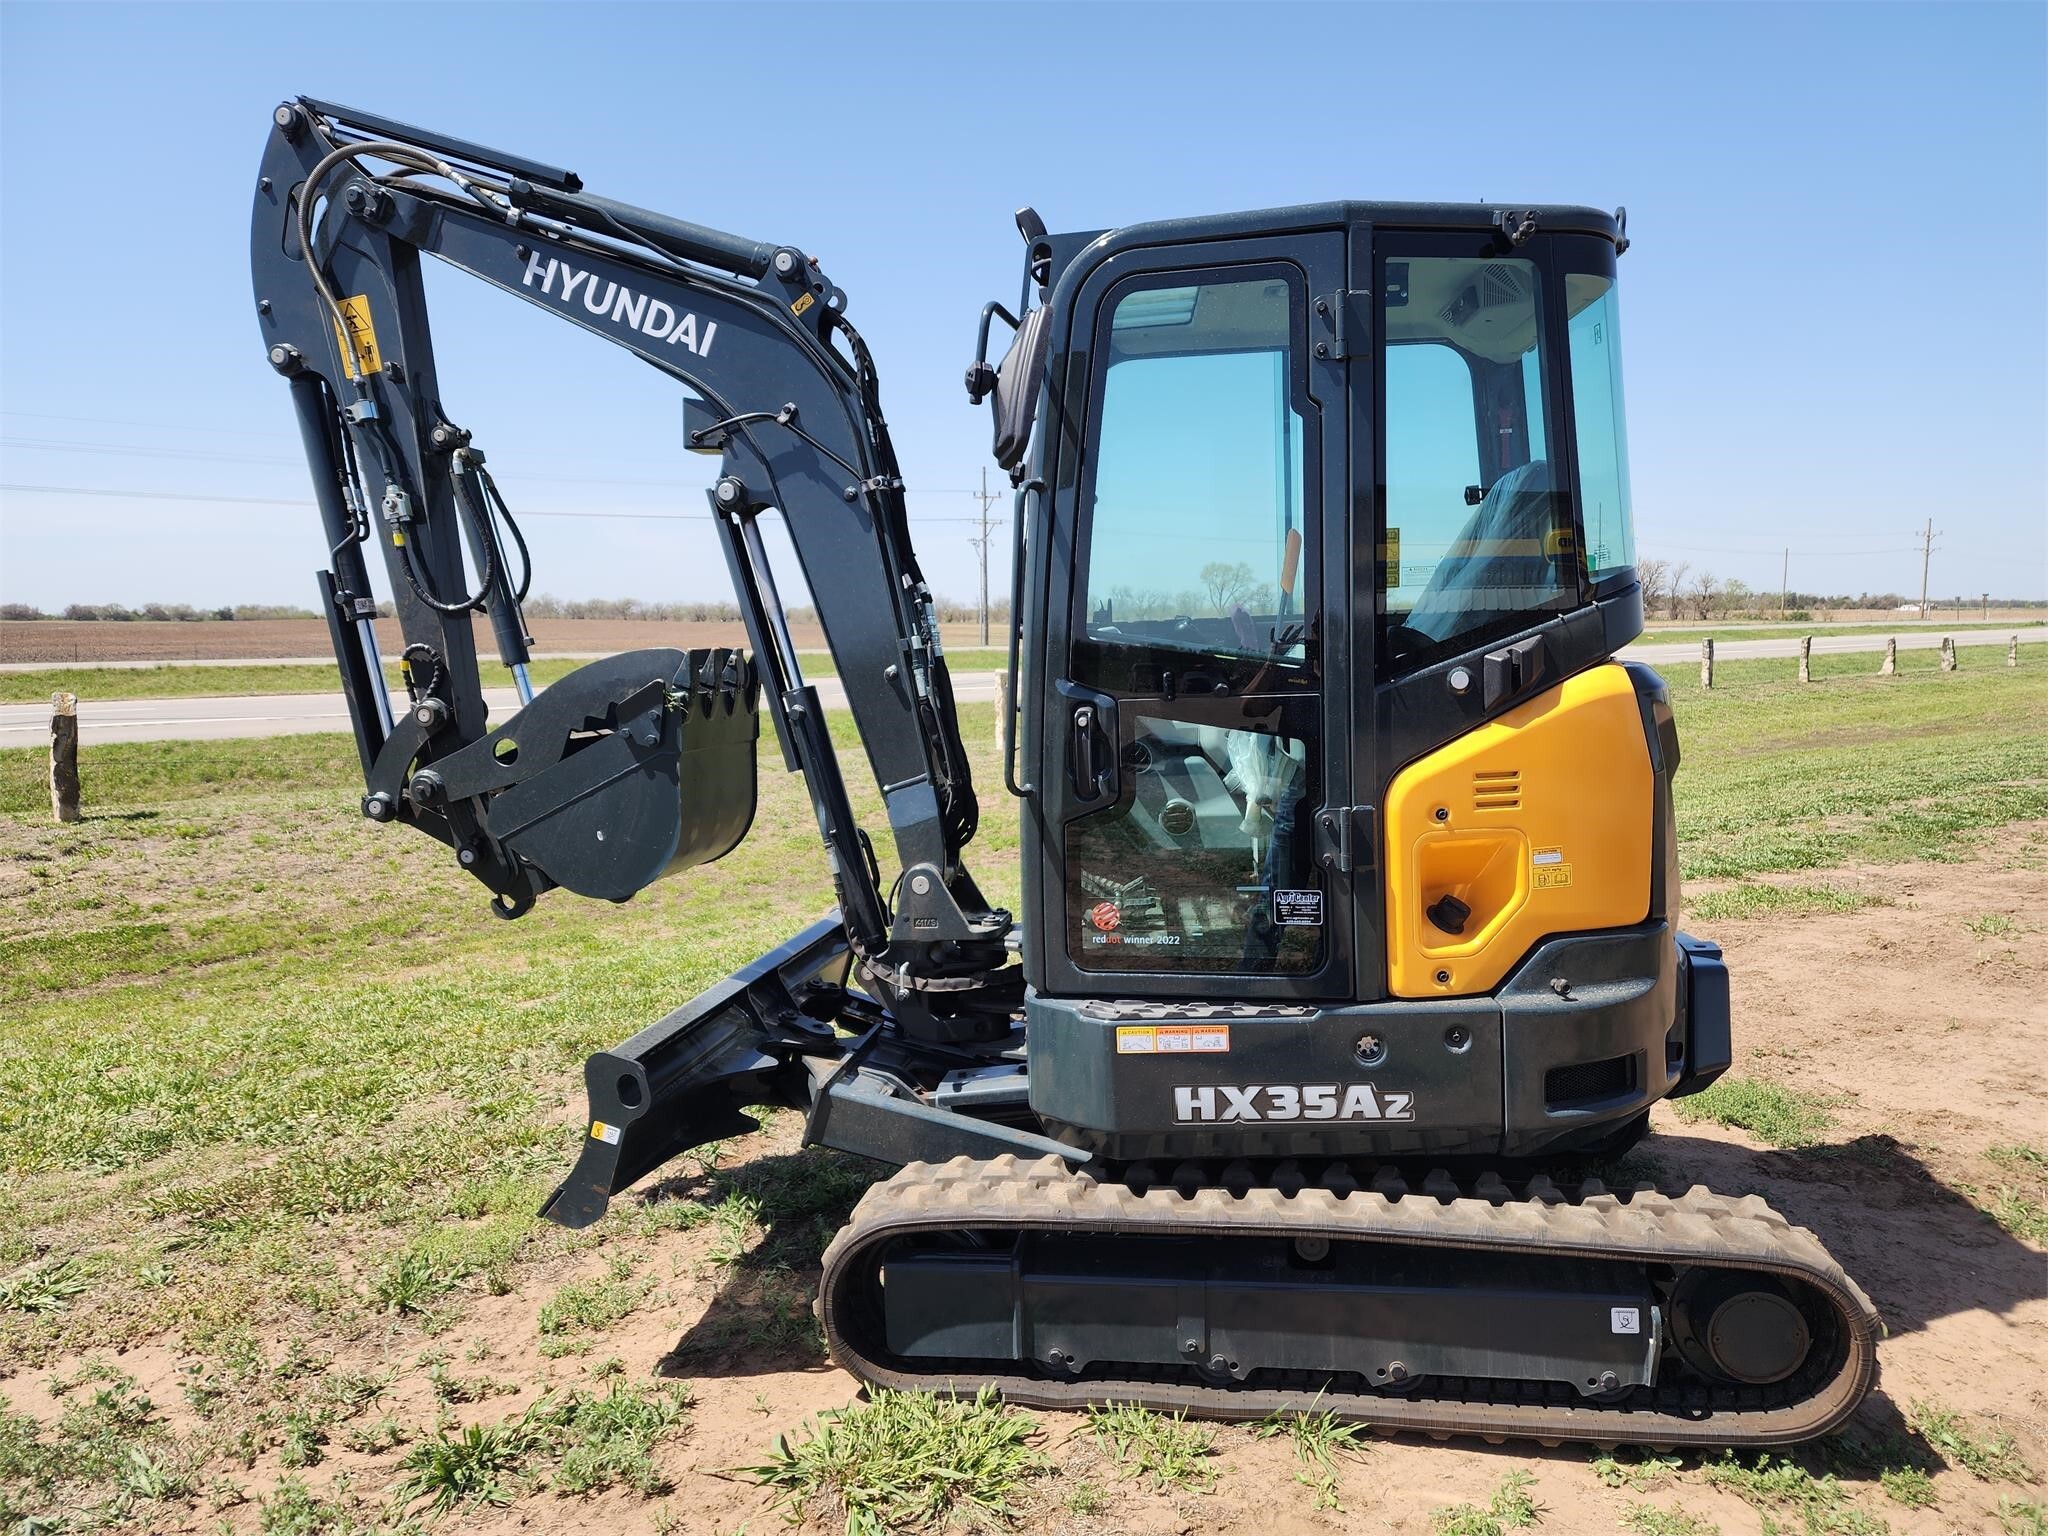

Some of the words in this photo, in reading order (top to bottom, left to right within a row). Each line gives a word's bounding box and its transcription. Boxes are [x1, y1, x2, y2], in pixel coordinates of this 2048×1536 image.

[522, 250, 717, 358] HYUNDAI
[1123, 935, 1153, 944] winner
[1156, 935, 1180, 945] 2022
